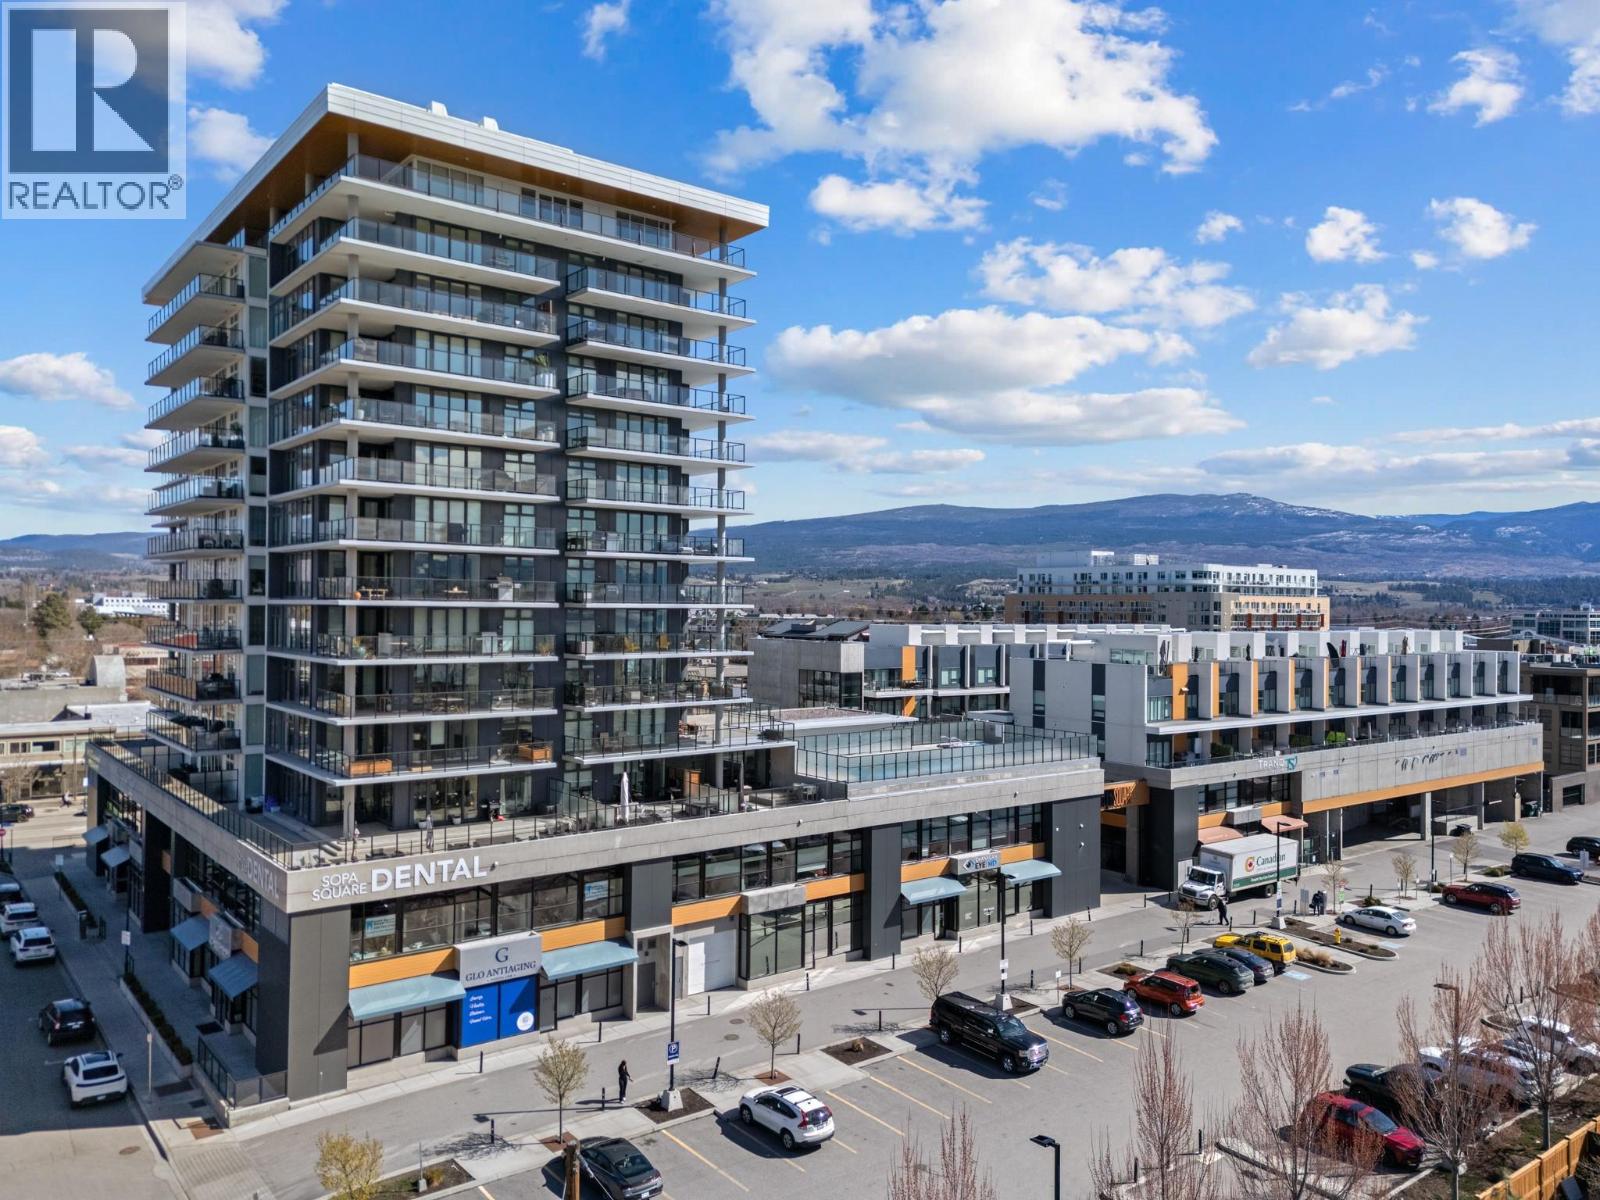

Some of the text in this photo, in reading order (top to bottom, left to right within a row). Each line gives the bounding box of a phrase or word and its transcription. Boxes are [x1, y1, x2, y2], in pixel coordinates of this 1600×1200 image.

[1256, 852, 1286, 866] Canadan
[322, 872, 359, 888] SOPA
[371, 855, 488, 892] DENTAL
[312, 883, 368, 901] SQUARE
[495, 947, 509, 963] G
[465, 970, 485, 982] GLO
[486, 961, 537, 978] ANTIAGING
